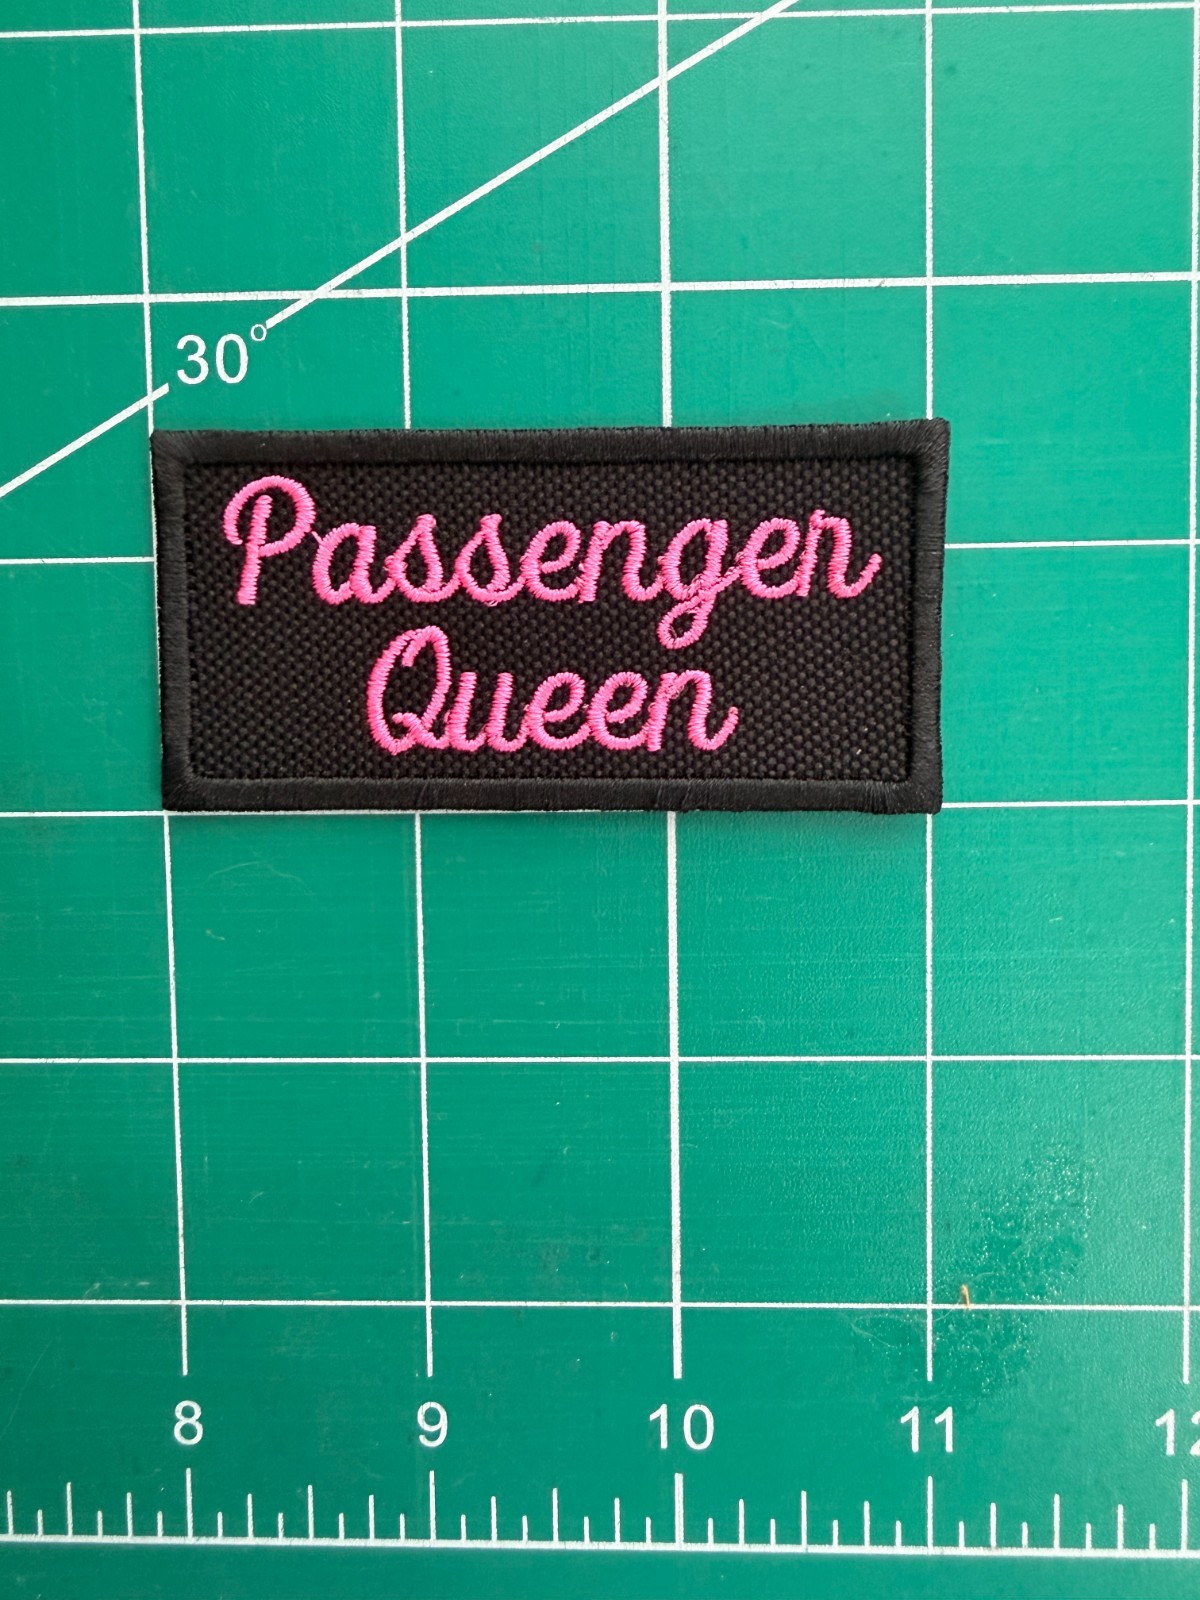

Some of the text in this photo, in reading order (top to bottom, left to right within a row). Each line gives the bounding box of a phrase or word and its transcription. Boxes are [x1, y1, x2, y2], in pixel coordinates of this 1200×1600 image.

[222, 474, 882, 651] Passenger
[366, 625, 739, 756] Queen
[173, 1400, 204, 1447] 8
[417, 1401, 449, 1449] 9
[648, 1403, 715, 1451] 10
[899, 1406, 955, 1454] 11
